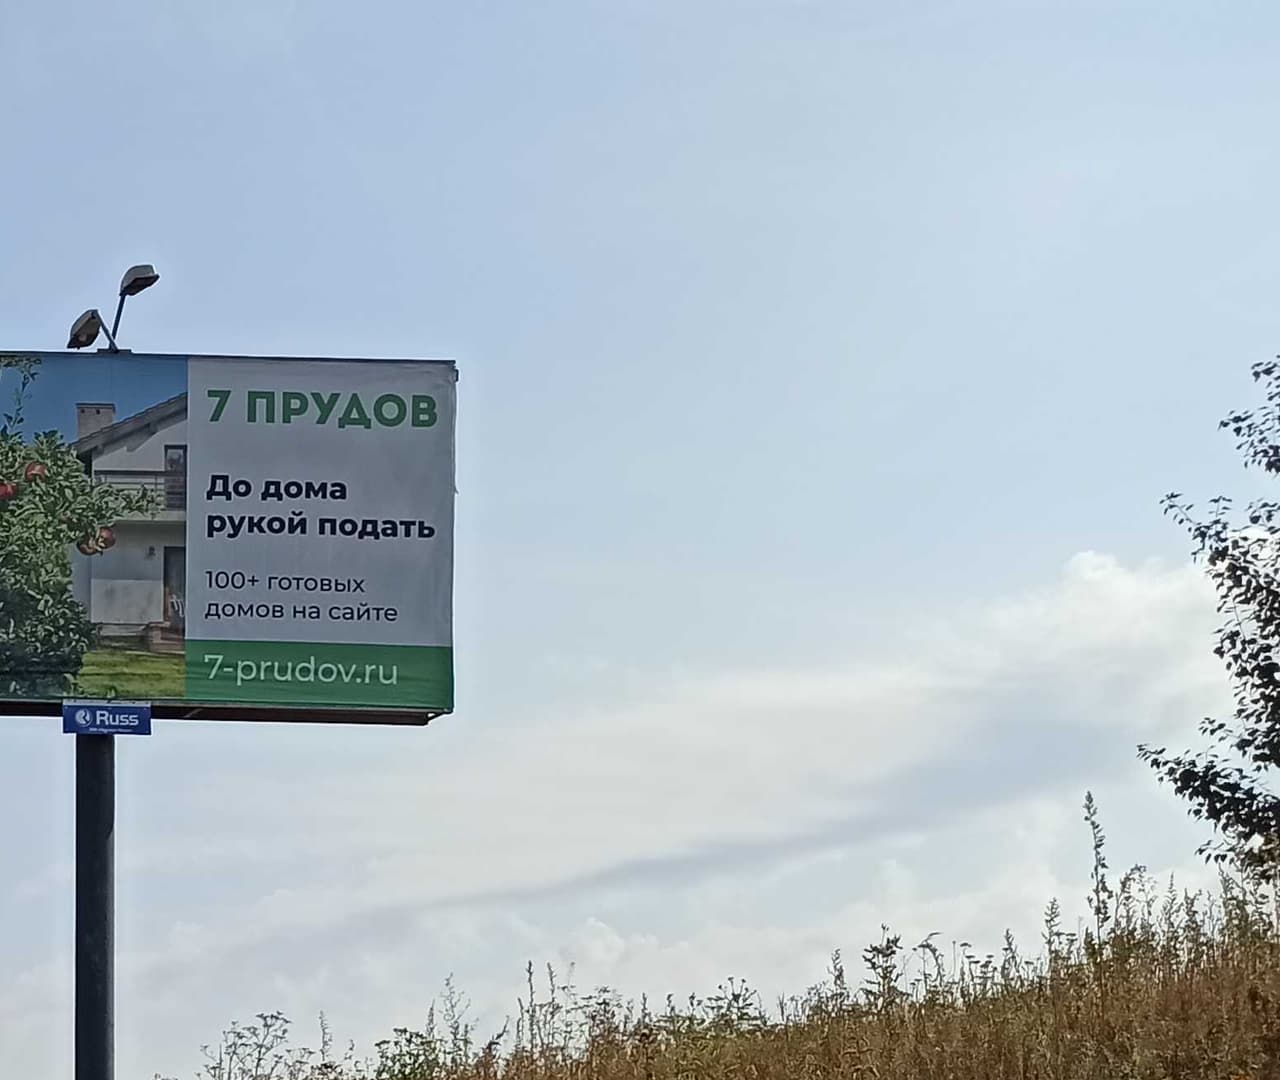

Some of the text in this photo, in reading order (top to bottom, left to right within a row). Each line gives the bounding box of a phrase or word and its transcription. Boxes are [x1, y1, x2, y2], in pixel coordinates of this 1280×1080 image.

[207, 389, 438, 429] 7 ПРУДОВ
[206, 475, 348, 501] До дома
[207, 511, 436, 540] рукой подать
[205, 571, 366, 593] 100+ готовых
[204, 602, 399, 622] домов на сайте
[204, 654, 399, 686] 7-prudov.ru
[95, 710, 139, 726] Russ
